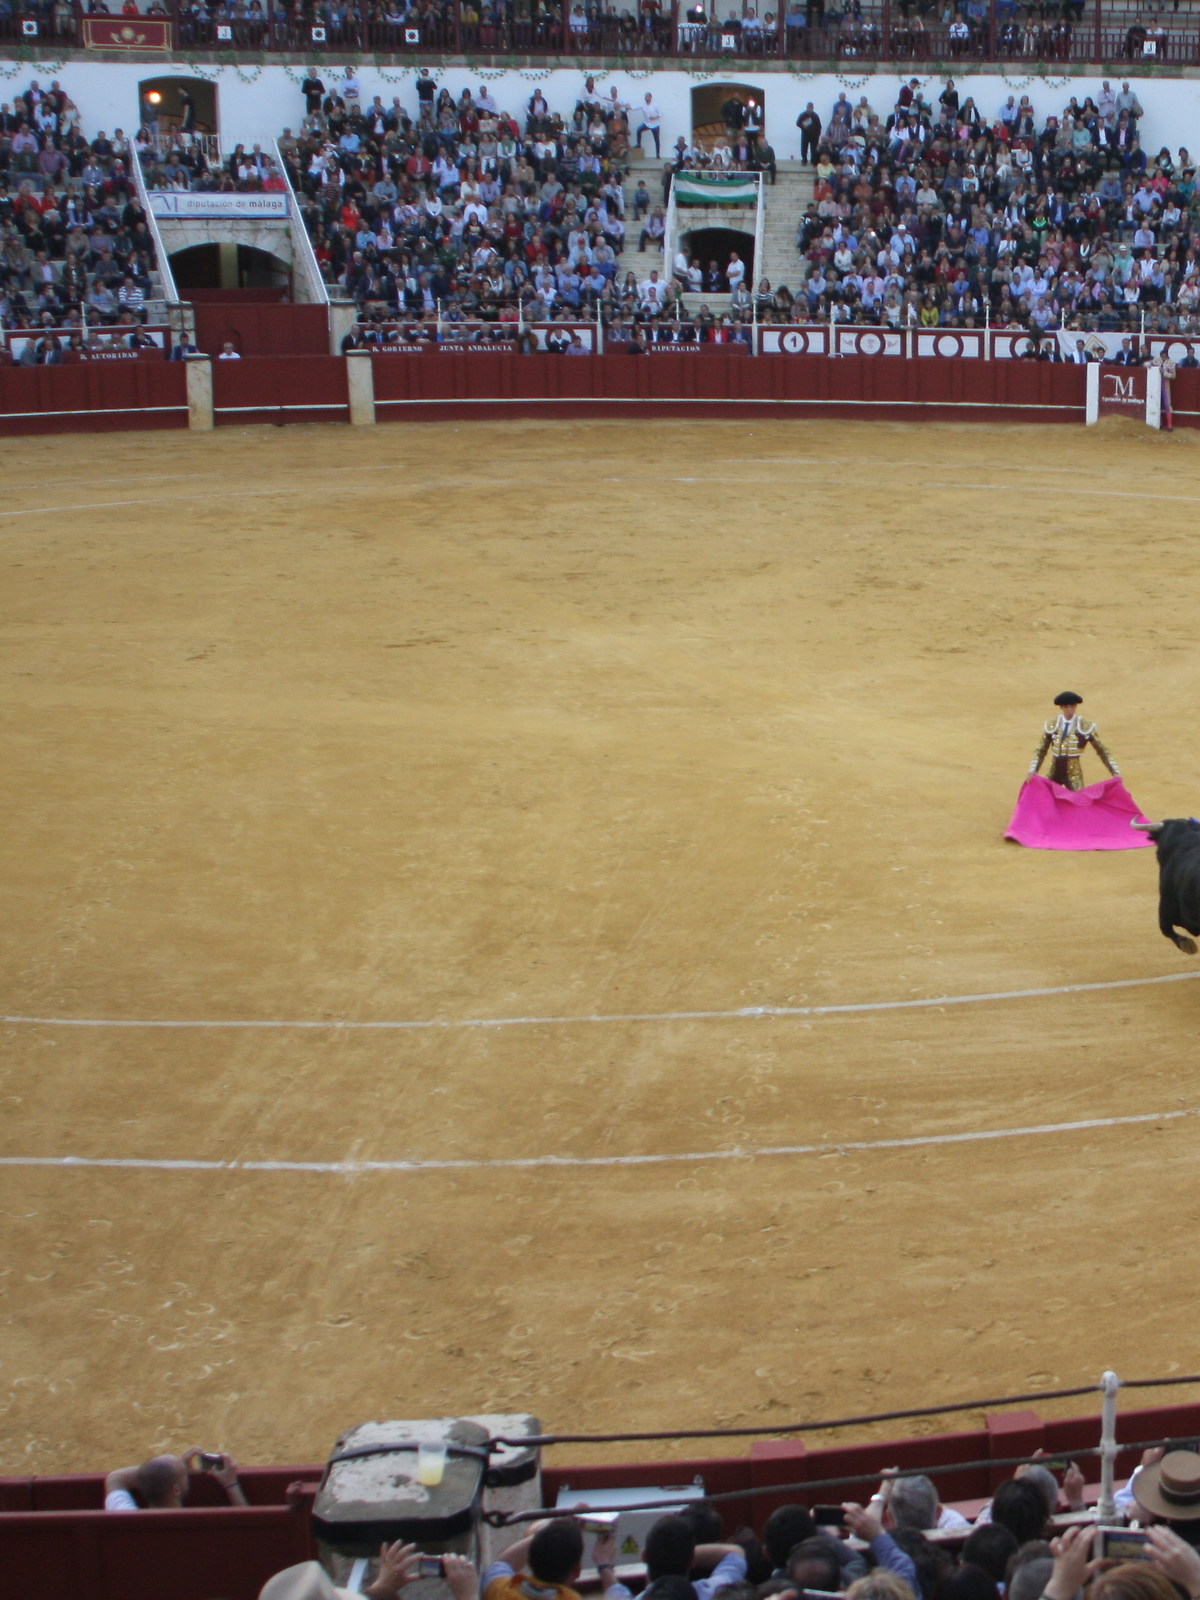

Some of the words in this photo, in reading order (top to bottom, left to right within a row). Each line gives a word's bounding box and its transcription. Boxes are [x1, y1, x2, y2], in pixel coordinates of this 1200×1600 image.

[235, 200, 246, 208] de
[249, 199, 283, 209] málaga
[1103, 374, 1135, 397] M
